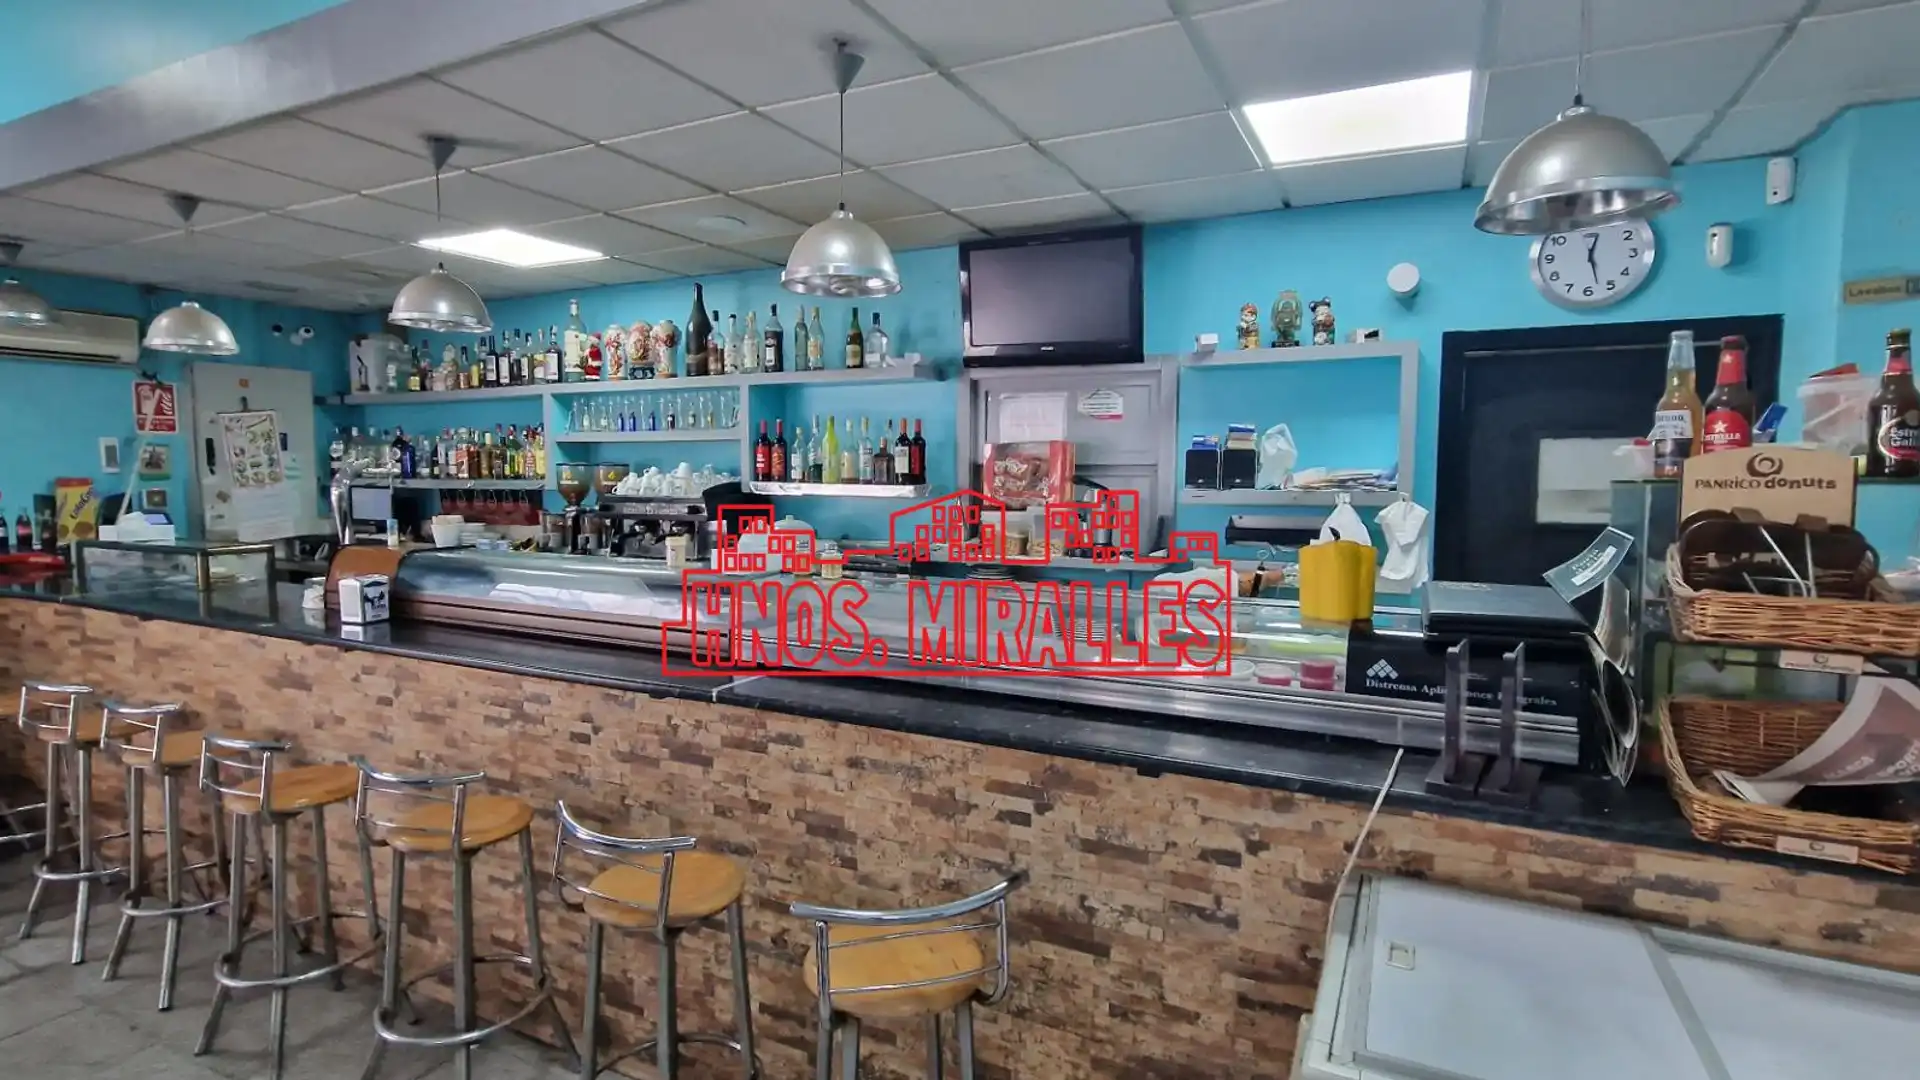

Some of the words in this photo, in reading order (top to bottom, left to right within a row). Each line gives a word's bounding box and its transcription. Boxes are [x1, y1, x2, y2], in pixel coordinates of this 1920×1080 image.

[1551, 235, 1566, 246] 10
[1623, 230, 1633, 241] 2
[1628, 248, 1638, 258] 3
[1544, 254, 1555, 264] 9
[1549, 271, 1560, 281] 8
[1620, 267, 1630, 276] 4
[1565, 283, 1574, 293] 7
[1606, 280, 1616, 290] 5
[1583, 286, 1594, 296] 6
[1764, 477, 1837, 490] donuts
